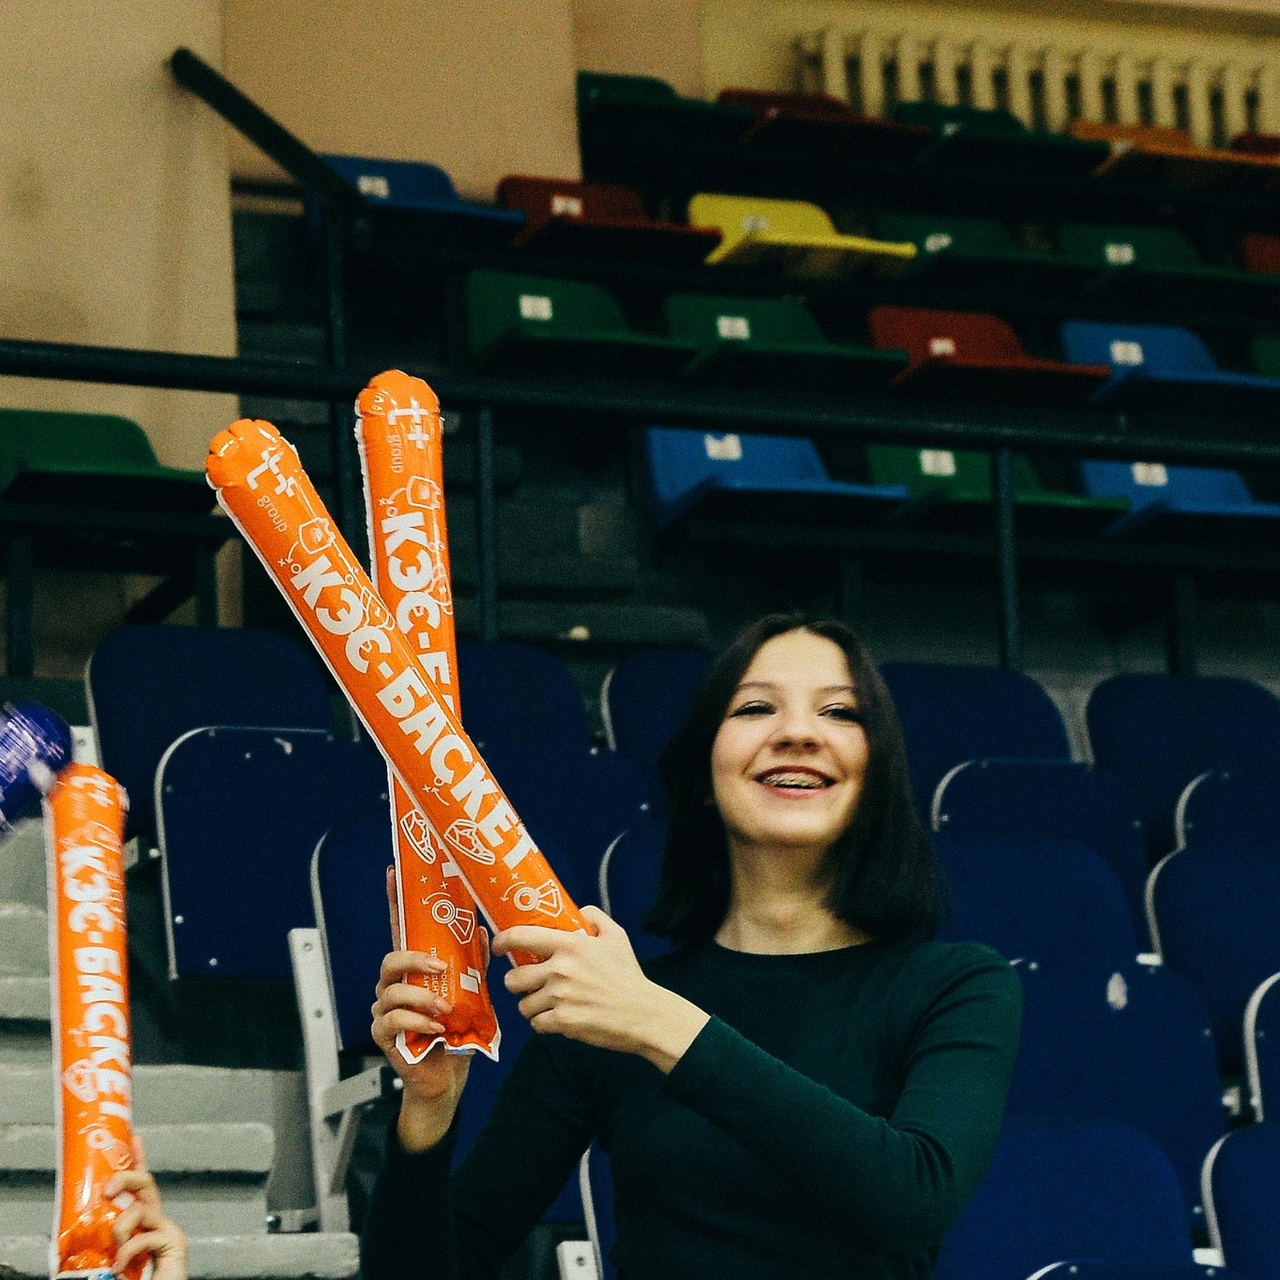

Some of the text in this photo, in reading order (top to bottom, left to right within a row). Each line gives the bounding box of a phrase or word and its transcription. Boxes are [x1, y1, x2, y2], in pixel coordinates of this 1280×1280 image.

[256, 494, 288, 533] group
[386, 433, 405, 474] group
[290, 555, 539, 870] КЭС-БАСКЕТ
[60, 846, 134, 1120] КЭС-БАСКЕТ
